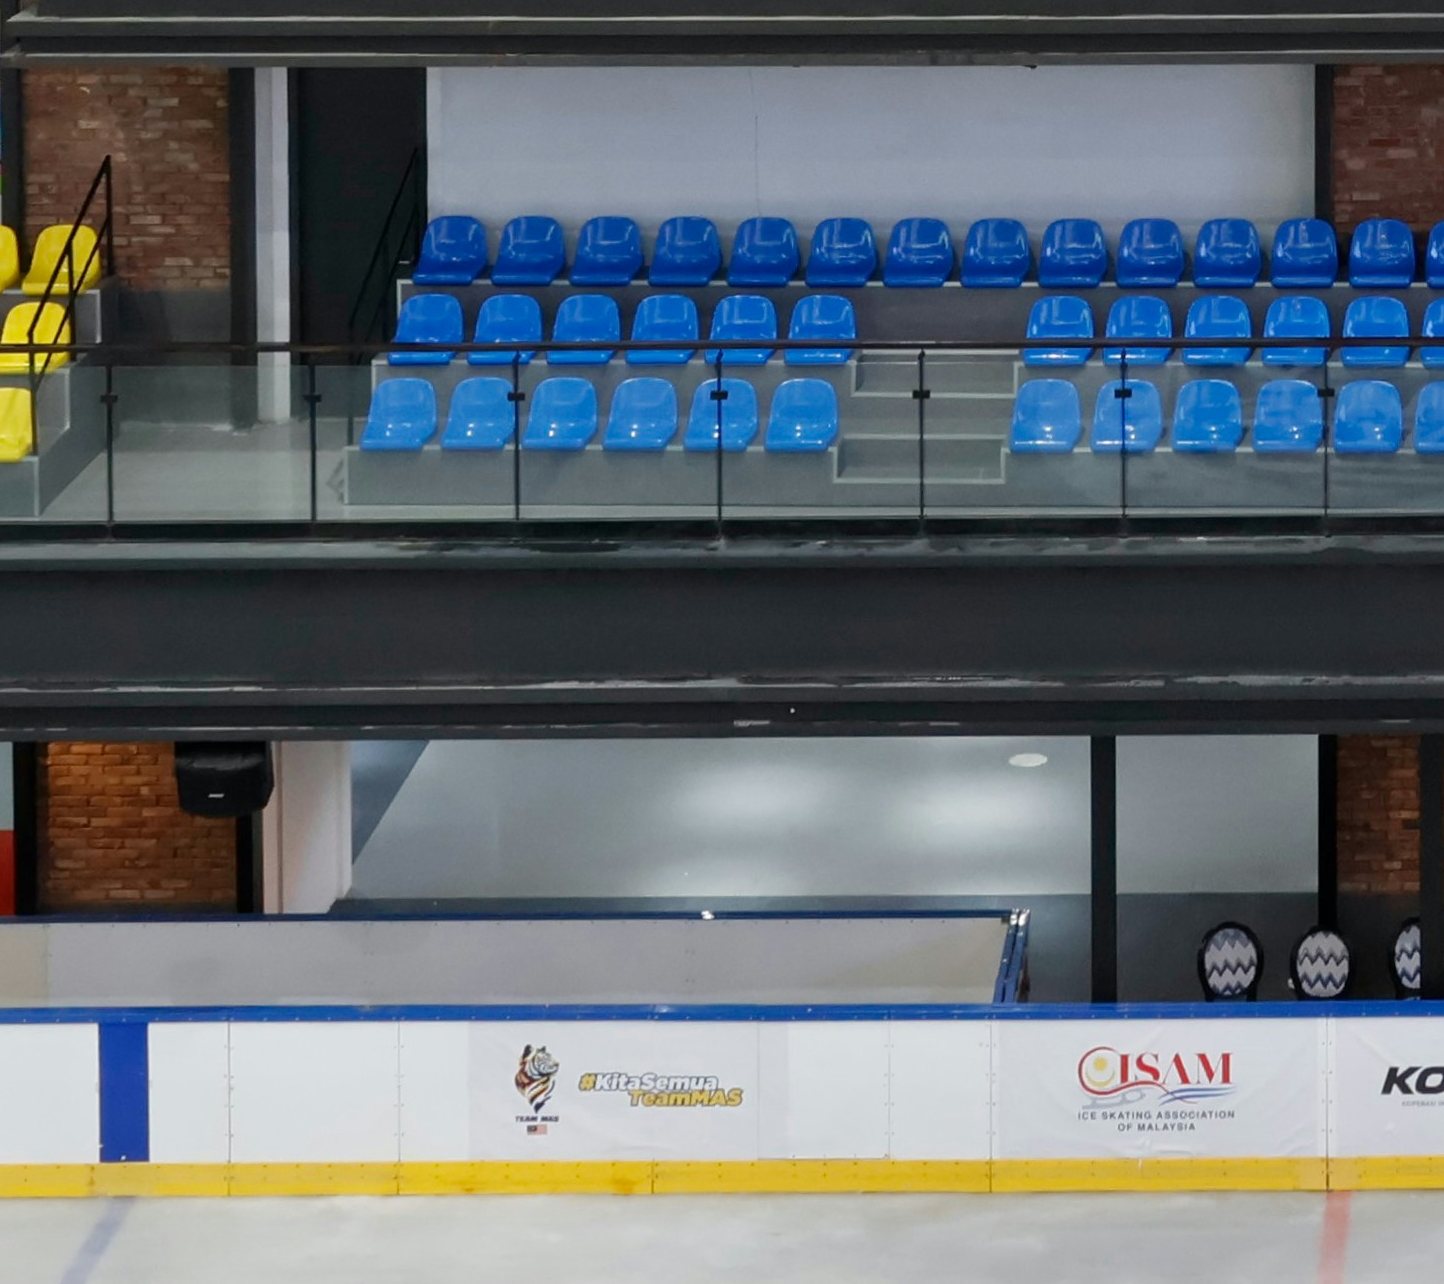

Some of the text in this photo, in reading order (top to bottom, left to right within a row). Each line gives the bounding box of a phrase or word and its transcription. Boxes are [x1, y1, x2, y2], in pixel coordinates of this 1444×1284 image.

[1118, 1052, 1235, 1084] ISAM
[578, 1073, 720, 1093] #KitaSemua
[628, 1088, 744, 1107] TeamMAS
[1077, 1110, 1235, 1120] ICE SKATING ASSOCIATION
[1117, 1122, 1196, 1132] OF MALAYSIA
